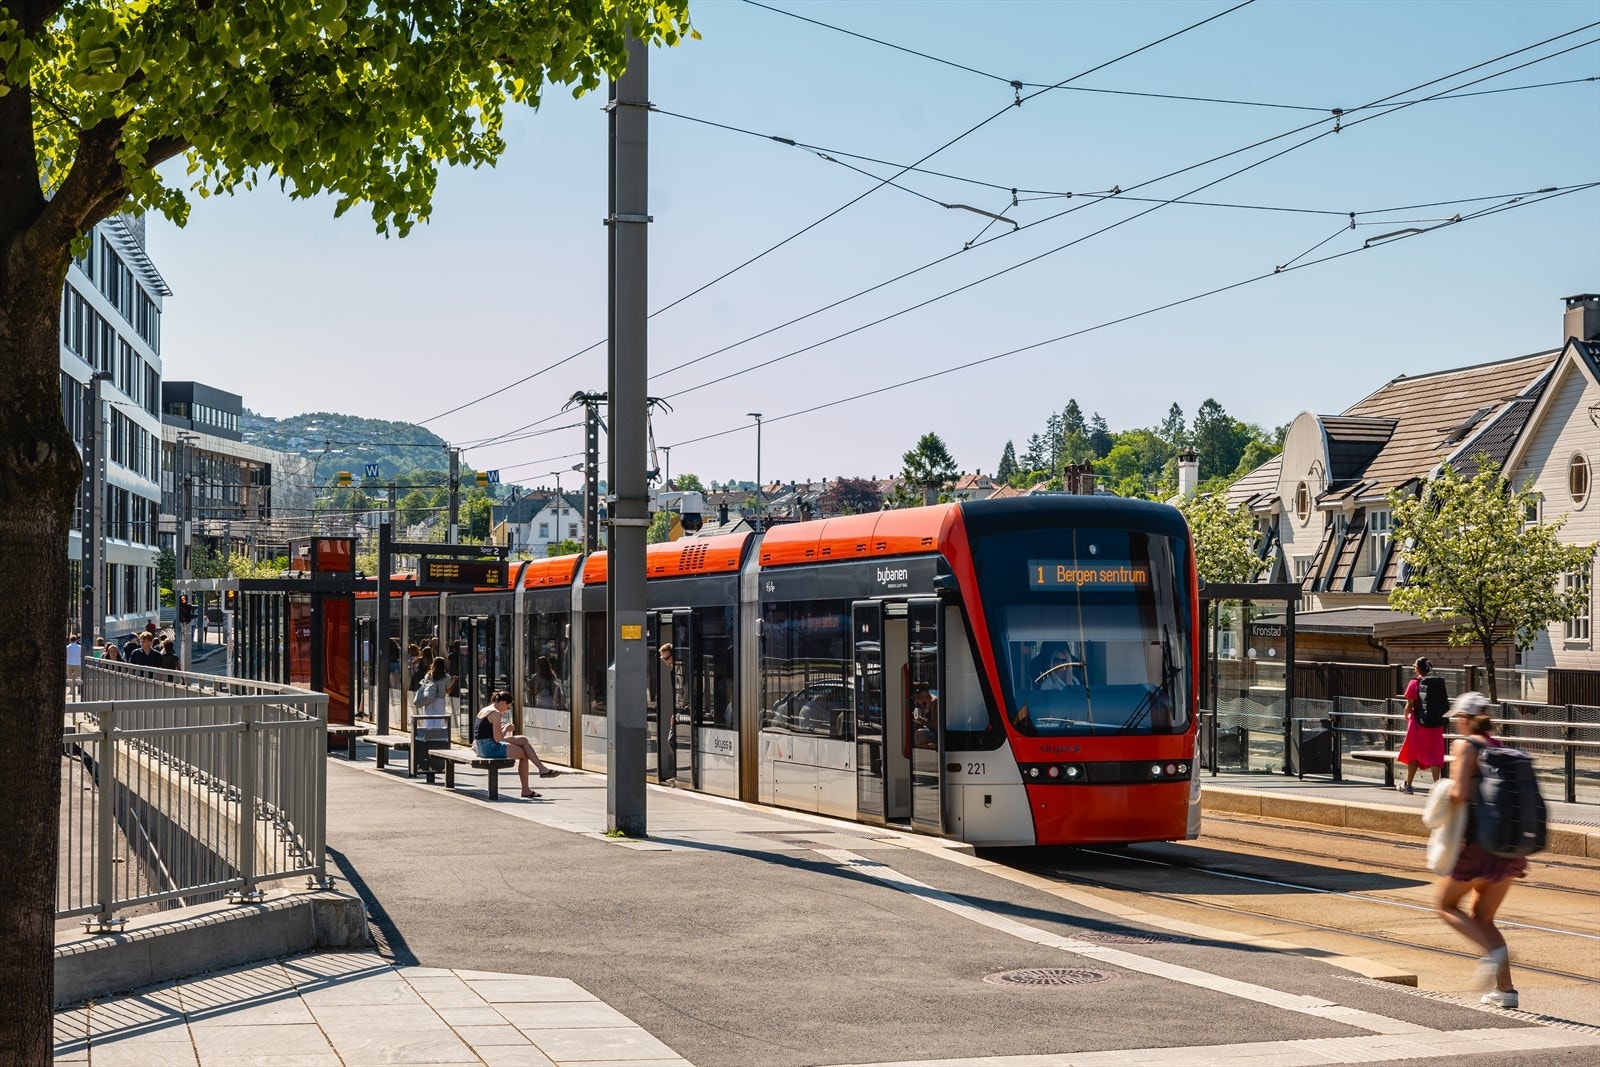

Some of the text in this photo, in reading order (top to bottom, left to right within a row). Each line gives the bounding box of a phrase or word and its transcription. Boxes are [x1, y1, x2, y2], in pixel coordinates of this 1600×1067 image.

[366, 466, 377, 477] W
[488, 471, 499, 482] W
[493, 547, 499, 555] 2
[877, 567, 908, 585] bybanen
[1037, 565, 1146, 586] 1 Bergen sentrum
[1252, 625, 1282, 637] Kronstad
[714, 737, 729, 751] skyss
[967, 762, 986, 775] 221
